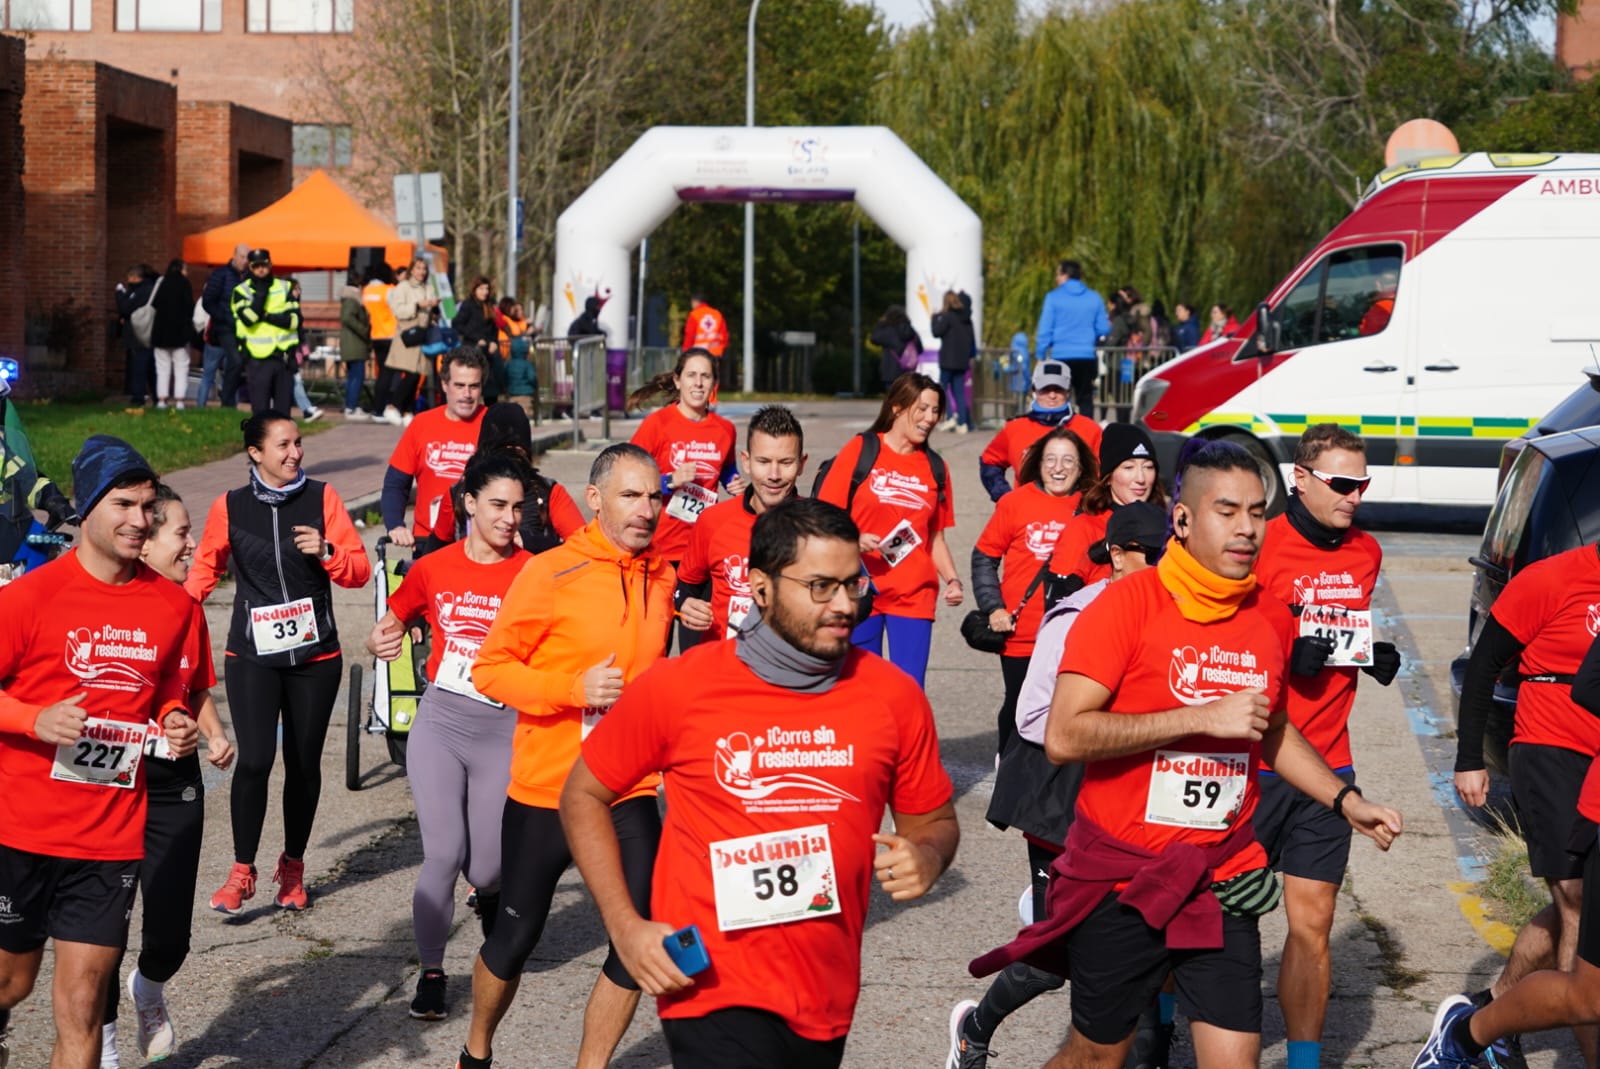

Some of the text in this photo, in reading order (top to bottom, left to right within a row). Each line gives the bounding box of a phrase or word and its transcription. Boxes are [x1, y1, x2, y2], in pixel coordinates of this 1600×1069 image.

[253, 603, 312, 623] bedunia
[102, 624, 147, 643] ¡Corre sin
[273, 620, 298, 640] 33
[95, 642, 157, 661] resistencias!
[1210, 645, 1256, 668] ¡Corre sin
[1202, 665, 1268, 688] resistencias!
[81, 724, 143, 744] edunia
[767, 725, 836, 748] ¡Corre sin
[73, 741, 126, 769] 227
[758, 744, 854, 768] resistencias!
[1156, 754, 1247, 777] bedunia
[1183, 780, 1221, 809] 59
[714, 834, 827, 869] bedunia
[752, 864, 799, 901] 58
